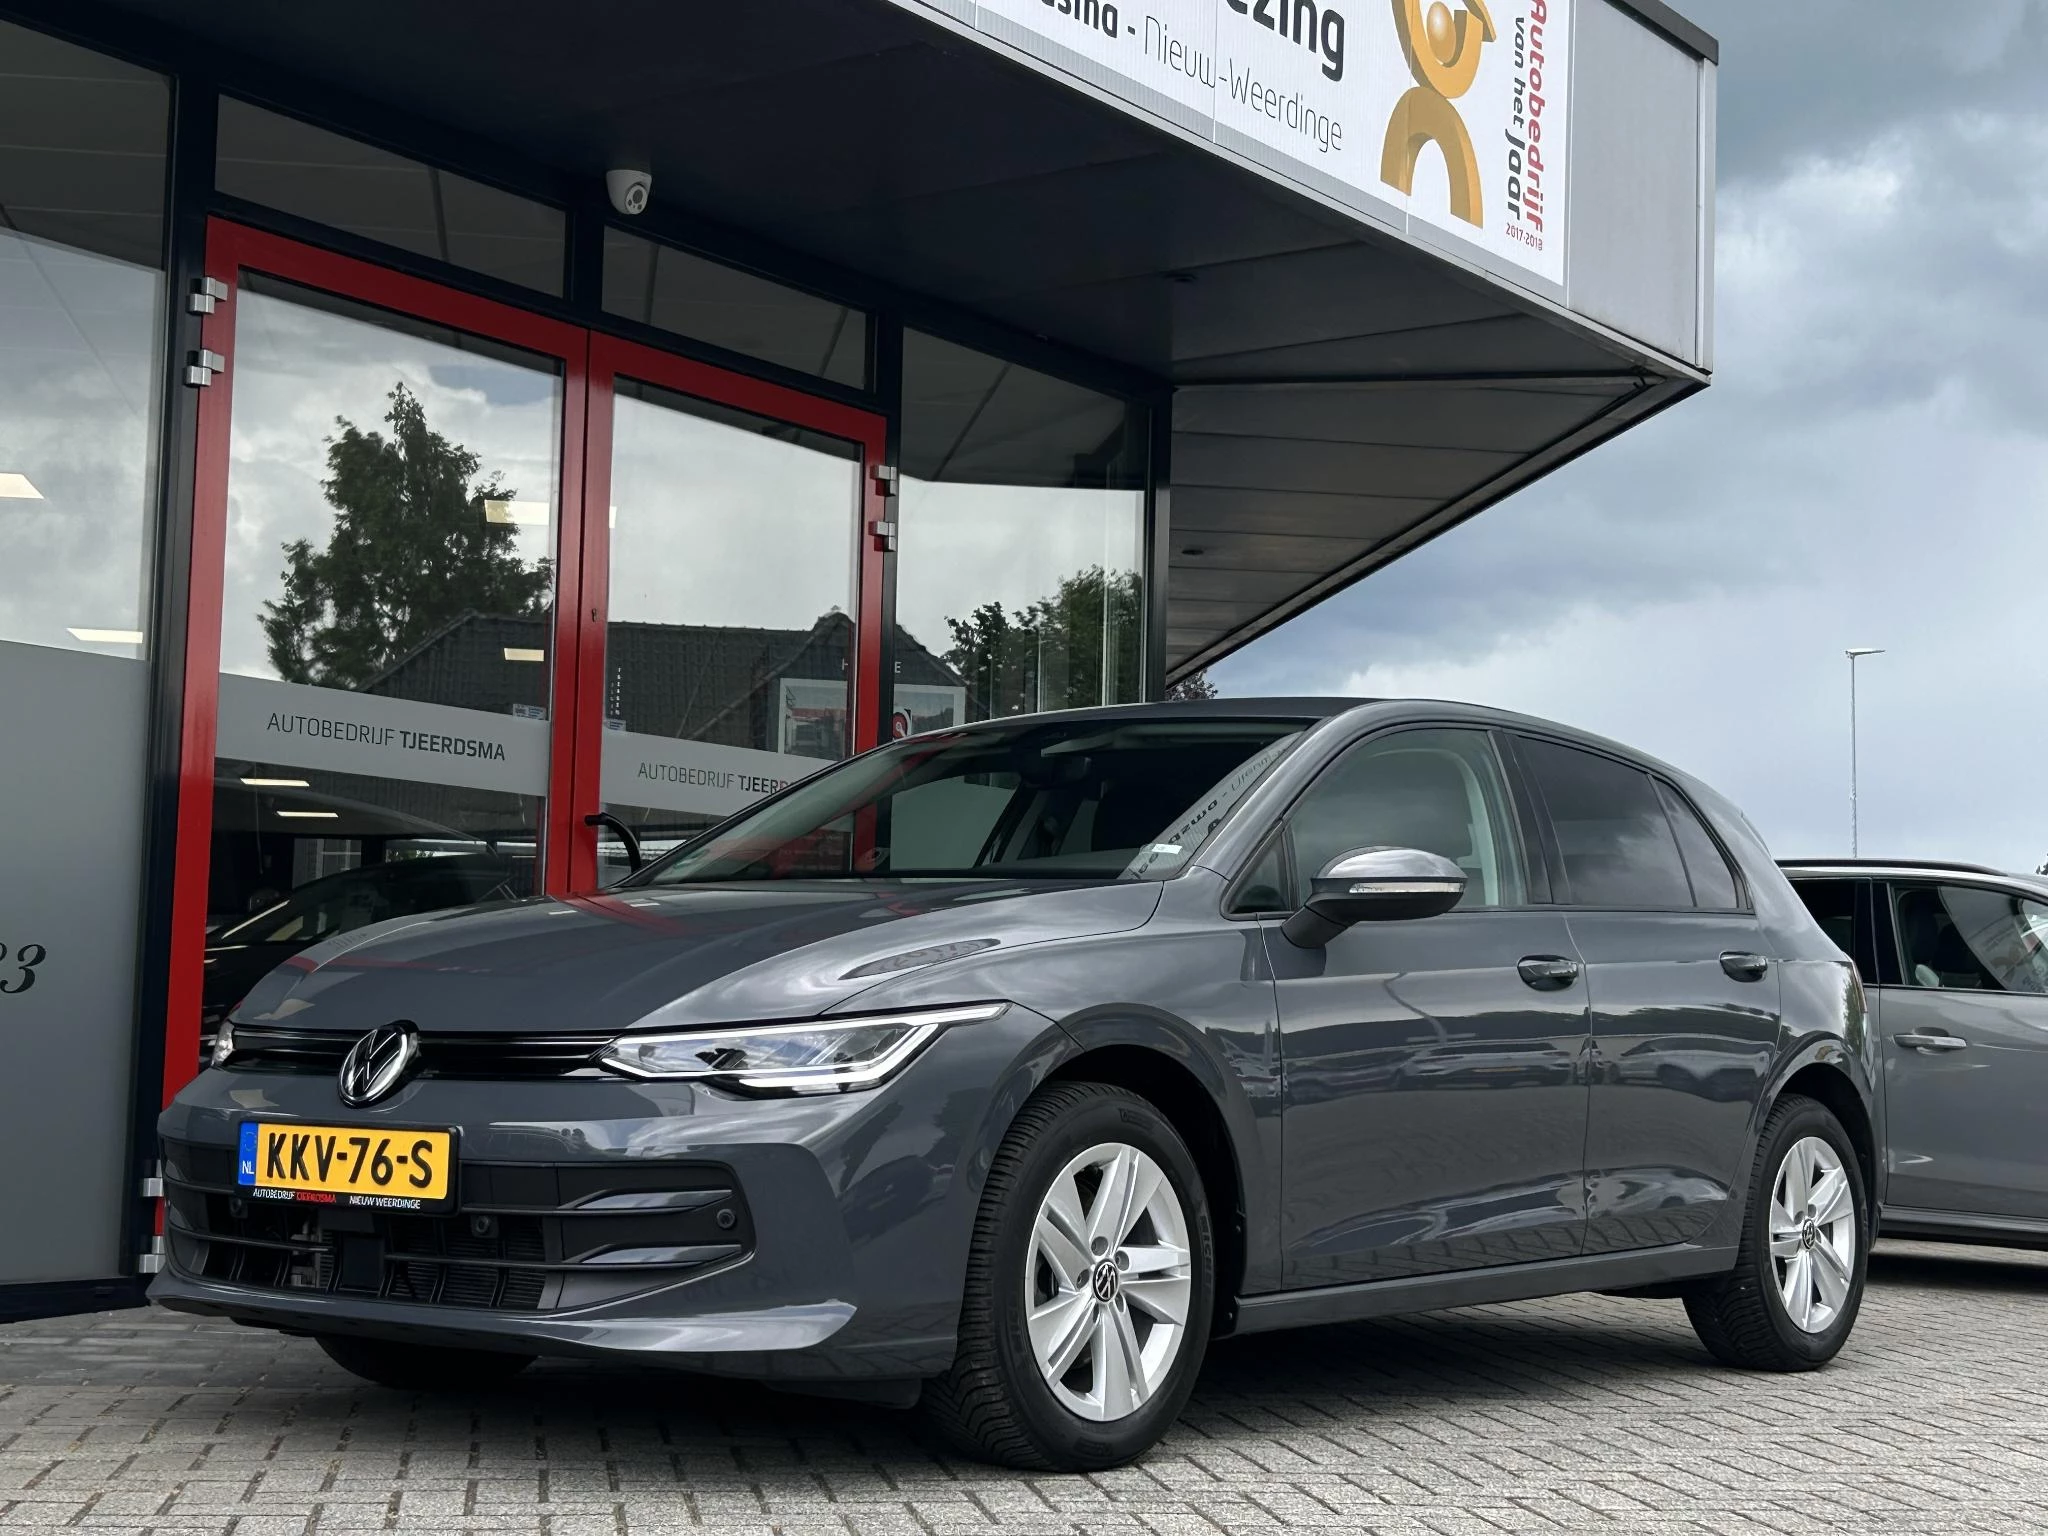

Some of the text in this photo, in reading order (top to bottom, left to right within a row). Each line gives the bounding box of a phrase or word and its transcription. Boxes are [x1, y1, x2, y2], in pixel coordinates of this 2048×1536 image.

[1514, 17, 1525, 69] van
[1513, 77, 1526, 128] het
[1523, 0, 1547, 232] Autobedrijf
[267, 712, 505, 761] AUTOBEDRIJF TJEERDSMA
[638, 761, 735, 789] AUTOBEDRIJF
[242, 1132, 433, 1189] NL KKV-76-S
[349, 1195, 375, 1207] NIEUW
